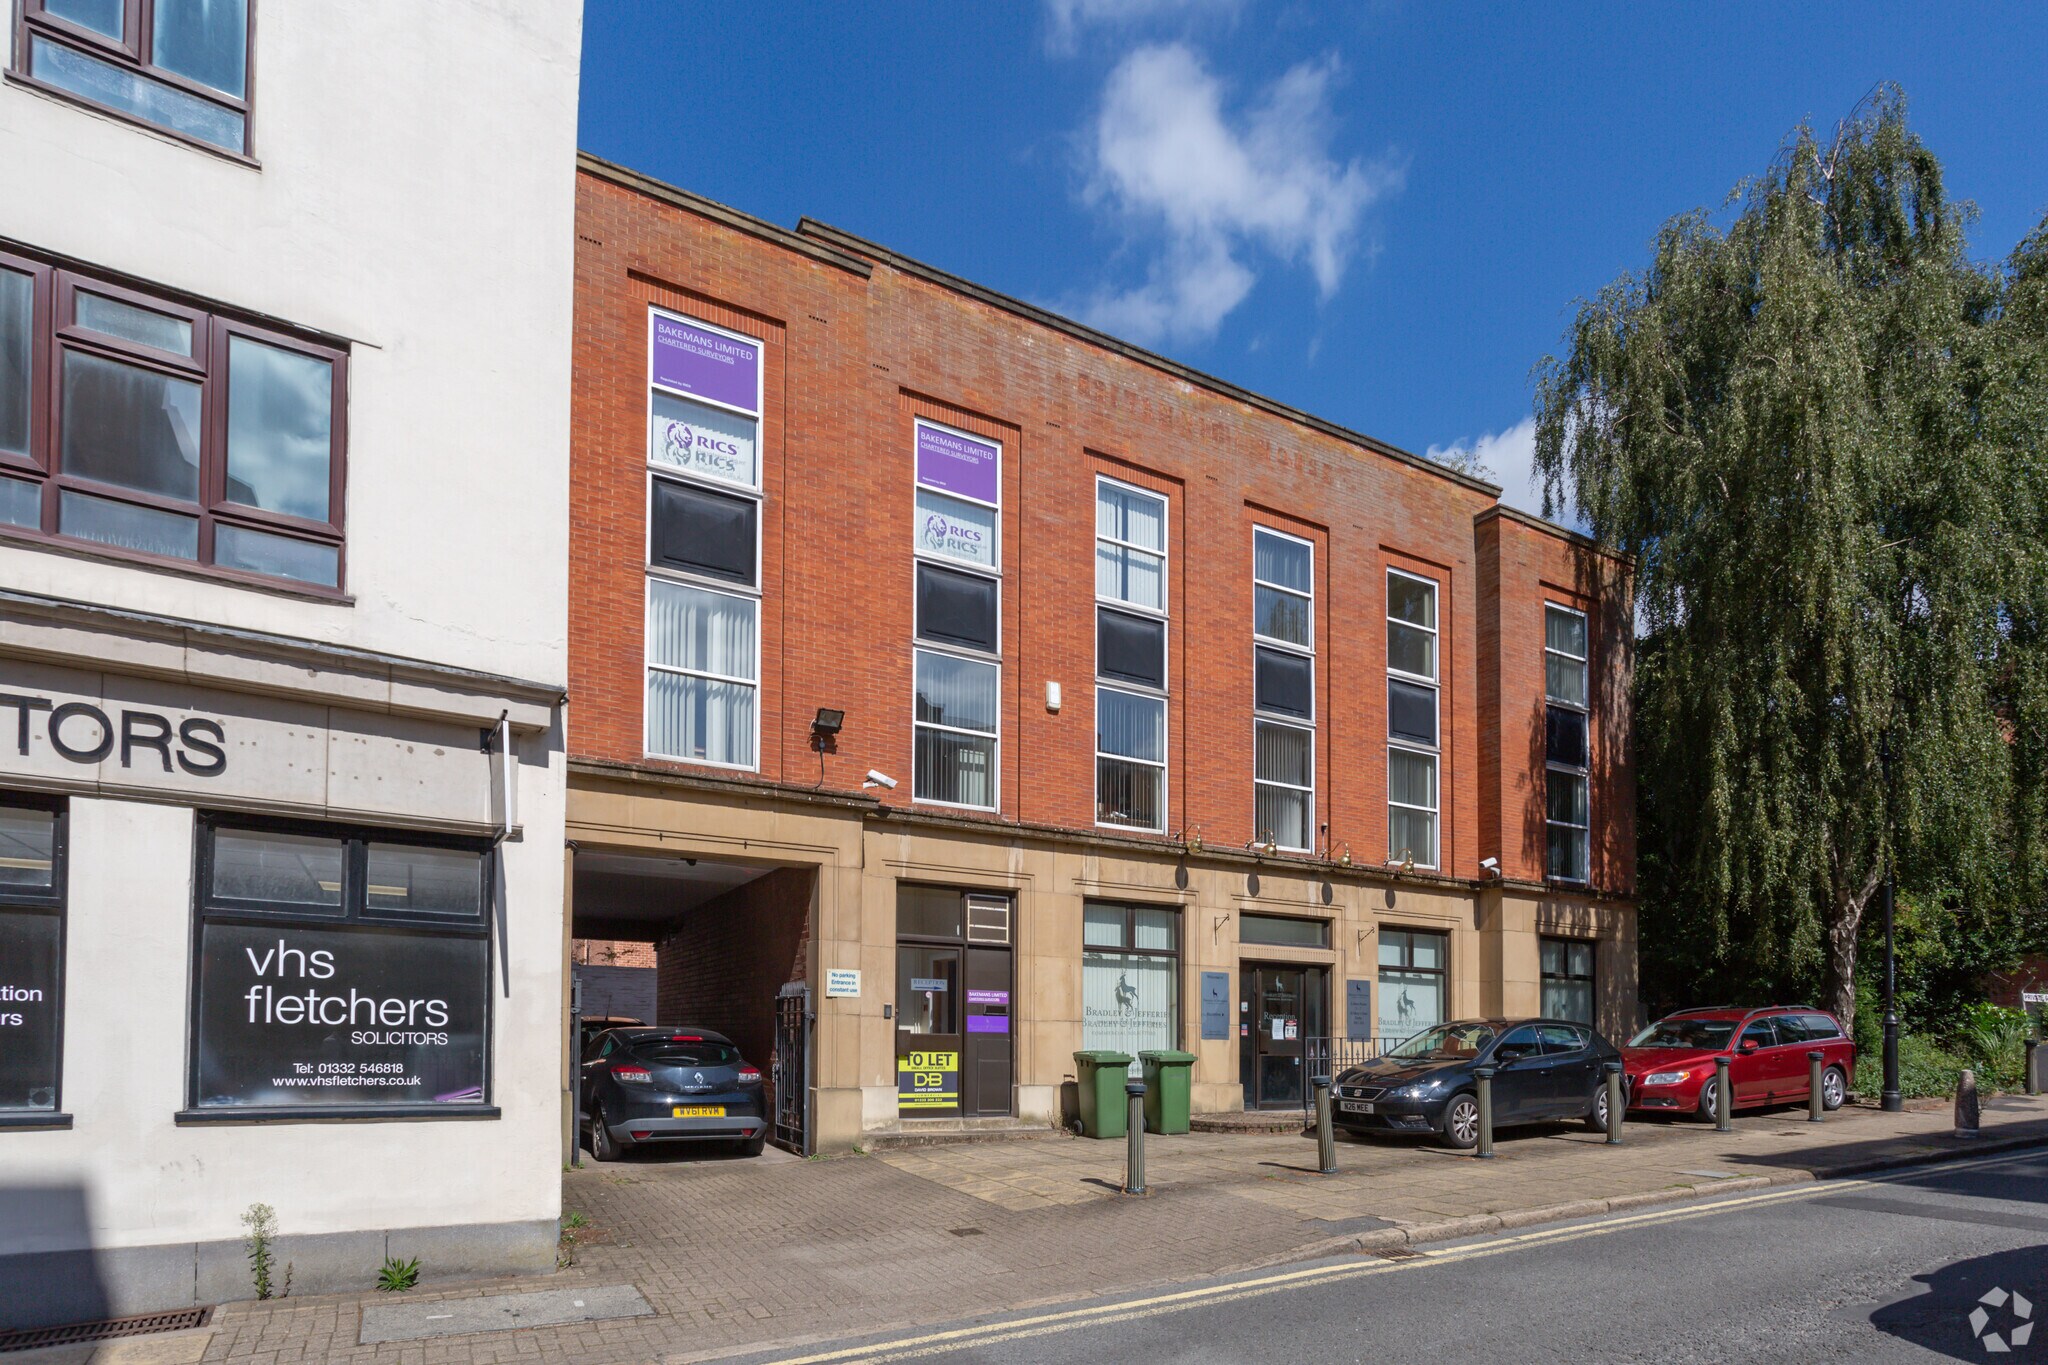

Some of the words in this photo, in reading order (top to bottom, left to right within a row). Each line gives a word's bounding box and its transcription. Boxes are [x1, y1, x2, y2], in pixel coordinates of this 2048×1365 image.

[658, 323, 713, 348] BAKEMANS
[715, 341, 753, 361] LIMITED
[658, 335, 697, 352] CHARTERED
[697, 347, 735, 364] SURVEYORS
[697, 435, 738, 455] RICS
[920, 431, 962, 451] BAKEMANS
[963, 445, 993, 461] LIMITED
[920, 441, 950, 456] CHARTERED
[950, 525, 981, 541] RICS
[0, 692, 227, 778] TORS
[246, 939, 335, 979] vhs
[244, 985, 449, 1027] fletchers
[1, 1013, 23, 1026] rs
[1263, 1011, 1296, 1021] Reception
[351, 1031, 448, 1045] SOLICITORS
[906, 1053, 923, 1066] TO
[928, 1053, 952, 1066] LET
[293, 1063, 314, 1074] Tel:
[318, 1063, 355, 1074] 01332
[359, 1063, 404, 1074] 546818
[272, 1075, 421, 1086] www.vhsfletchers.co.uk
[1344, 1103, 1355, 1111] N26
[1356, 1103, 1369, 1112] MEE
